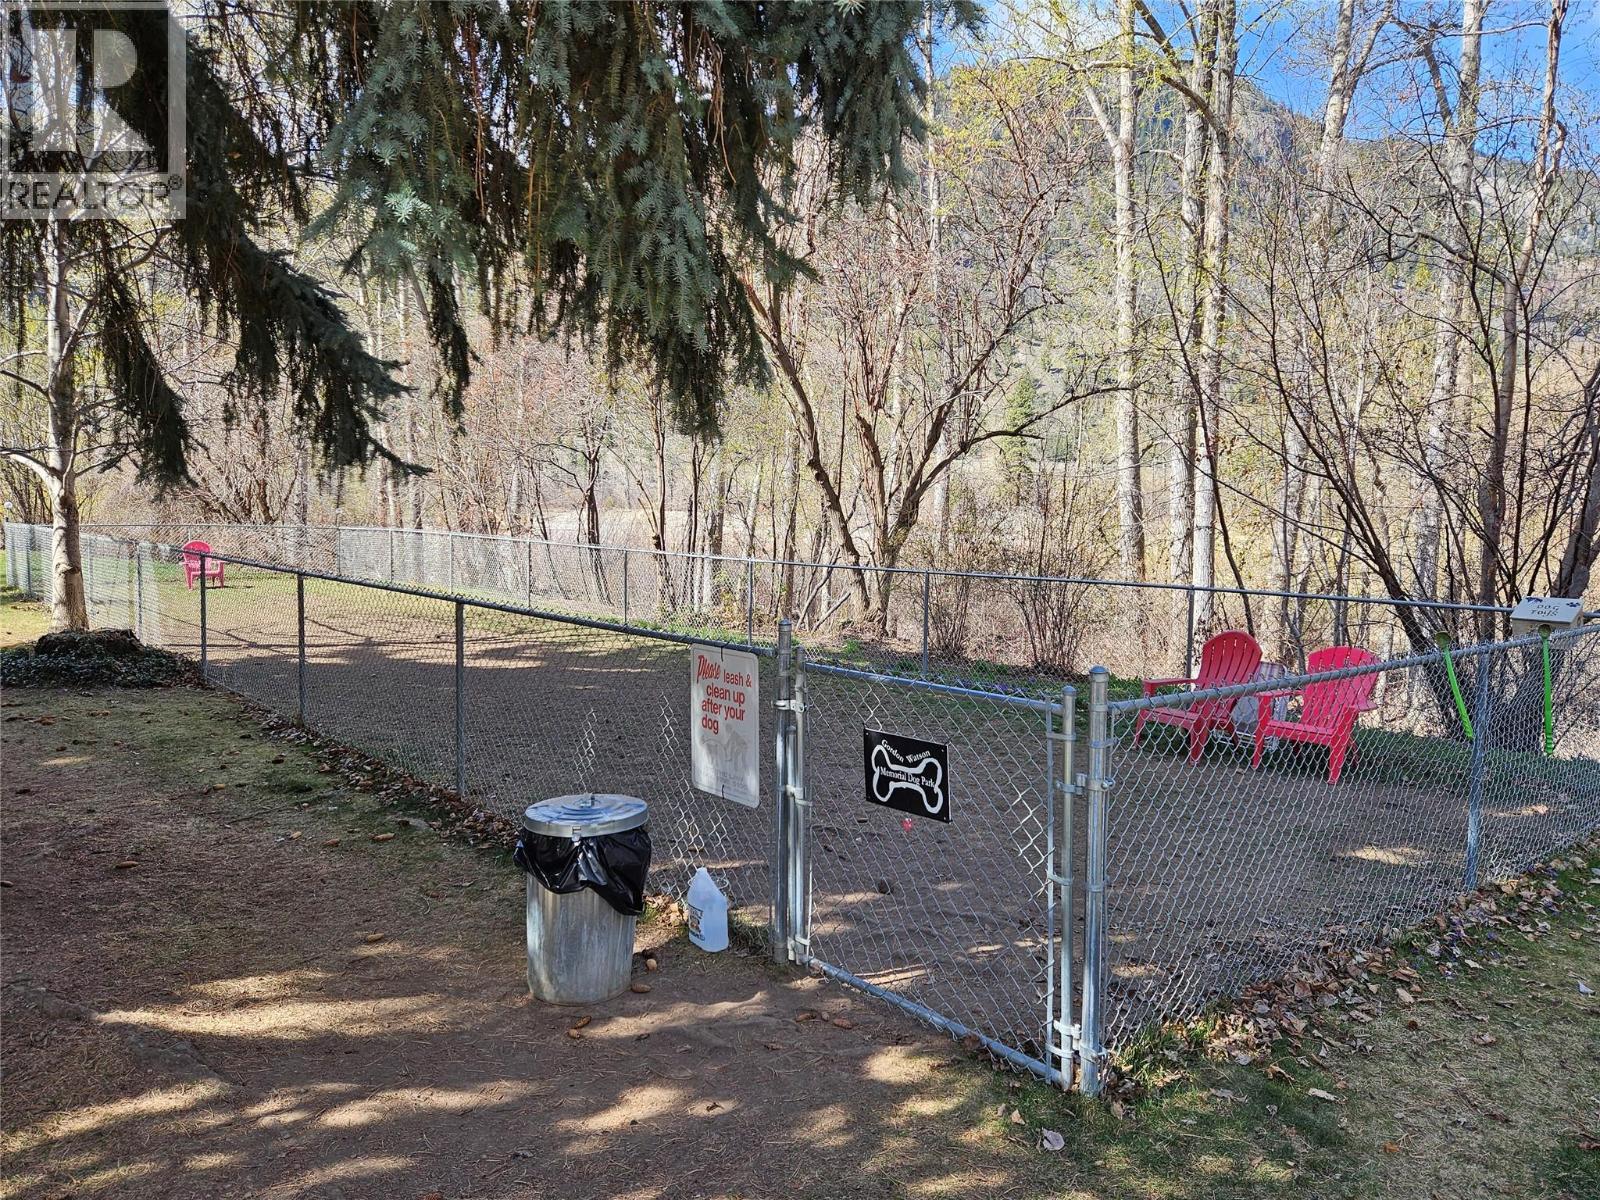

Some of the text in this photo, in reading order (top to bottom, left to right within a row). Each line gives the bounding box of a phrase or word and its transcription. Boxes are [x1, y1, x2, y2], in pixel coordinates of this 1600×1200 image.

[696, 654, 752, 688] Please leash &
[706, 682, 746, 707] clean up
[701, 698, 746, 721] after your
[701, 713, 719, 735] dog
[881, 739, 931, 764] Gordon Watson
[877, 766, 937, 788] Memorial Dog Park
